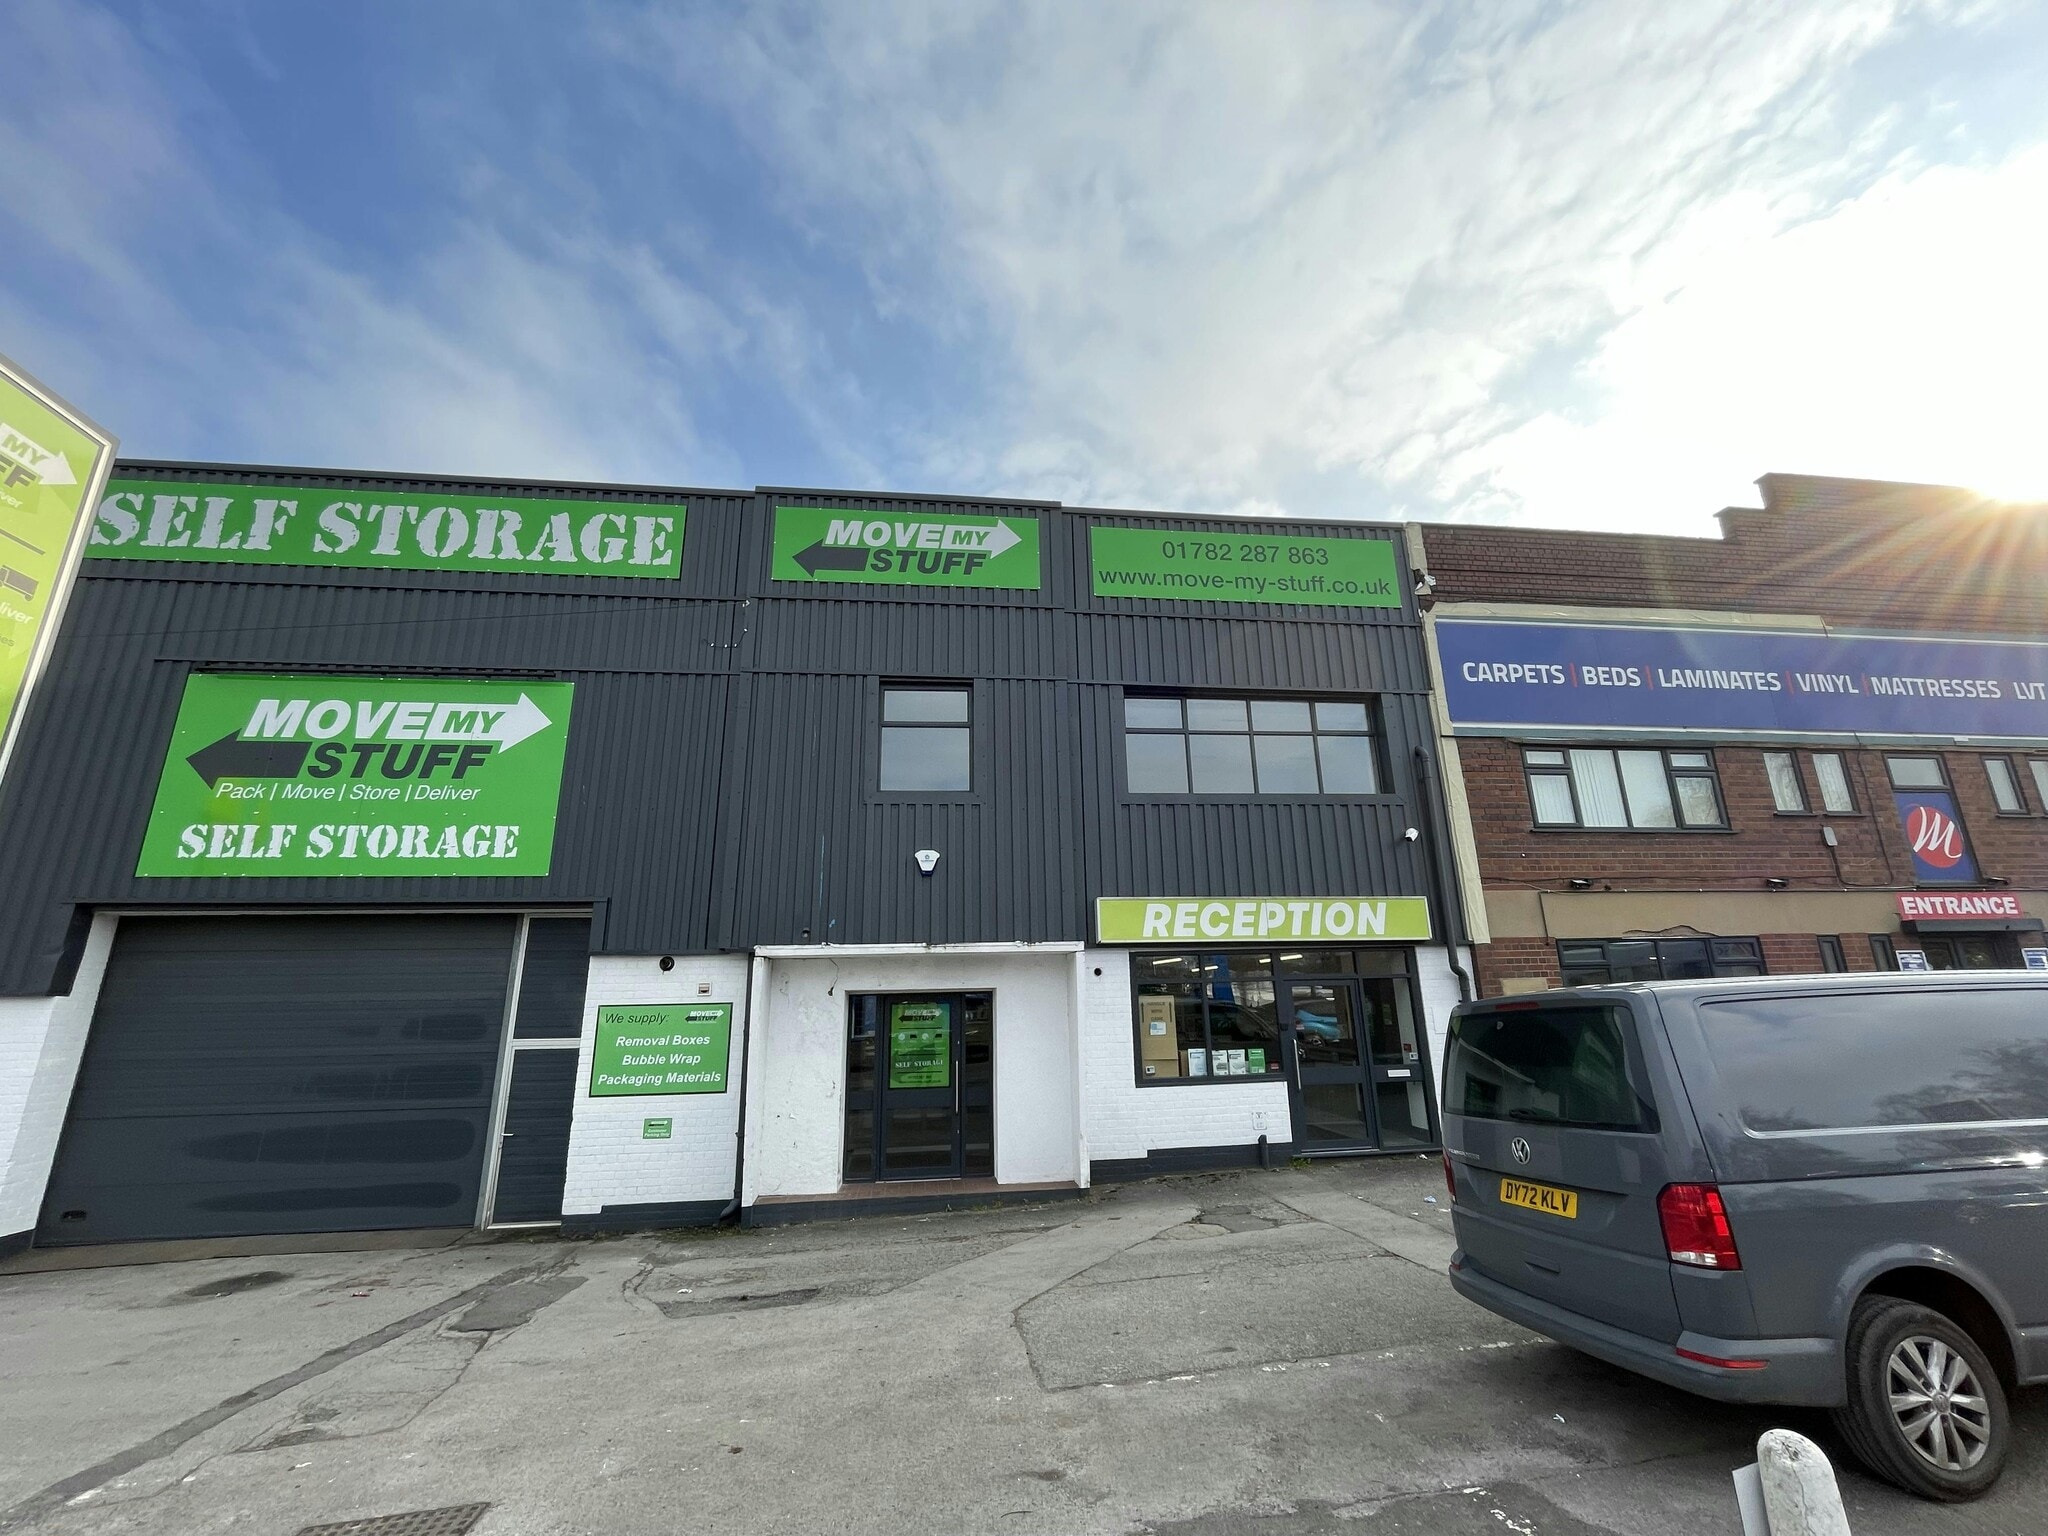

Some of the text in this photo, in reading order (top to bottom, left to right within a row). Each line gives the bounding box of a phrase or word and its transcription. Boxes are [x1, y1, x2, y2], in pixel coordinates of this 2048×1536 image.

[1, 433, 48, 466] MY
[90, 492, 674, 566] SELF STORAGE
[824, 519, 991, 549] MOVE MY
[870, 548, 987, 576] STUFF
[1162, 540, 1329, 566] 01782 287 863
[1099, 569, 1392, 595] www.move-my-stuff.co.uk
[1462, 661, 2046, 700] CARPETS BEDS LAMINATES VINYL MATTRESSES LVT
[243, 698, 506, 740] MOVE MY
[307, 742, 494, 780] STUFF
[215, 782, 481, 802] Pack Move Store Deliver
[177, 824, 520, 859] SELF STORAGE
[1142, 902, 1387, 938] RECEPTION
[1900, 896, 2019, 915] ENTRANCE
[605, 1012, 669, 1026] We supply:
[615, 1035, 711, 1047] Removal Boxes
[622, 1053, 701, 1066] Bubble Wrap
[597, 1071, 721, 1087] Packaging Materials
[1505, 1182, 1571, 1213] DY72 KLV
